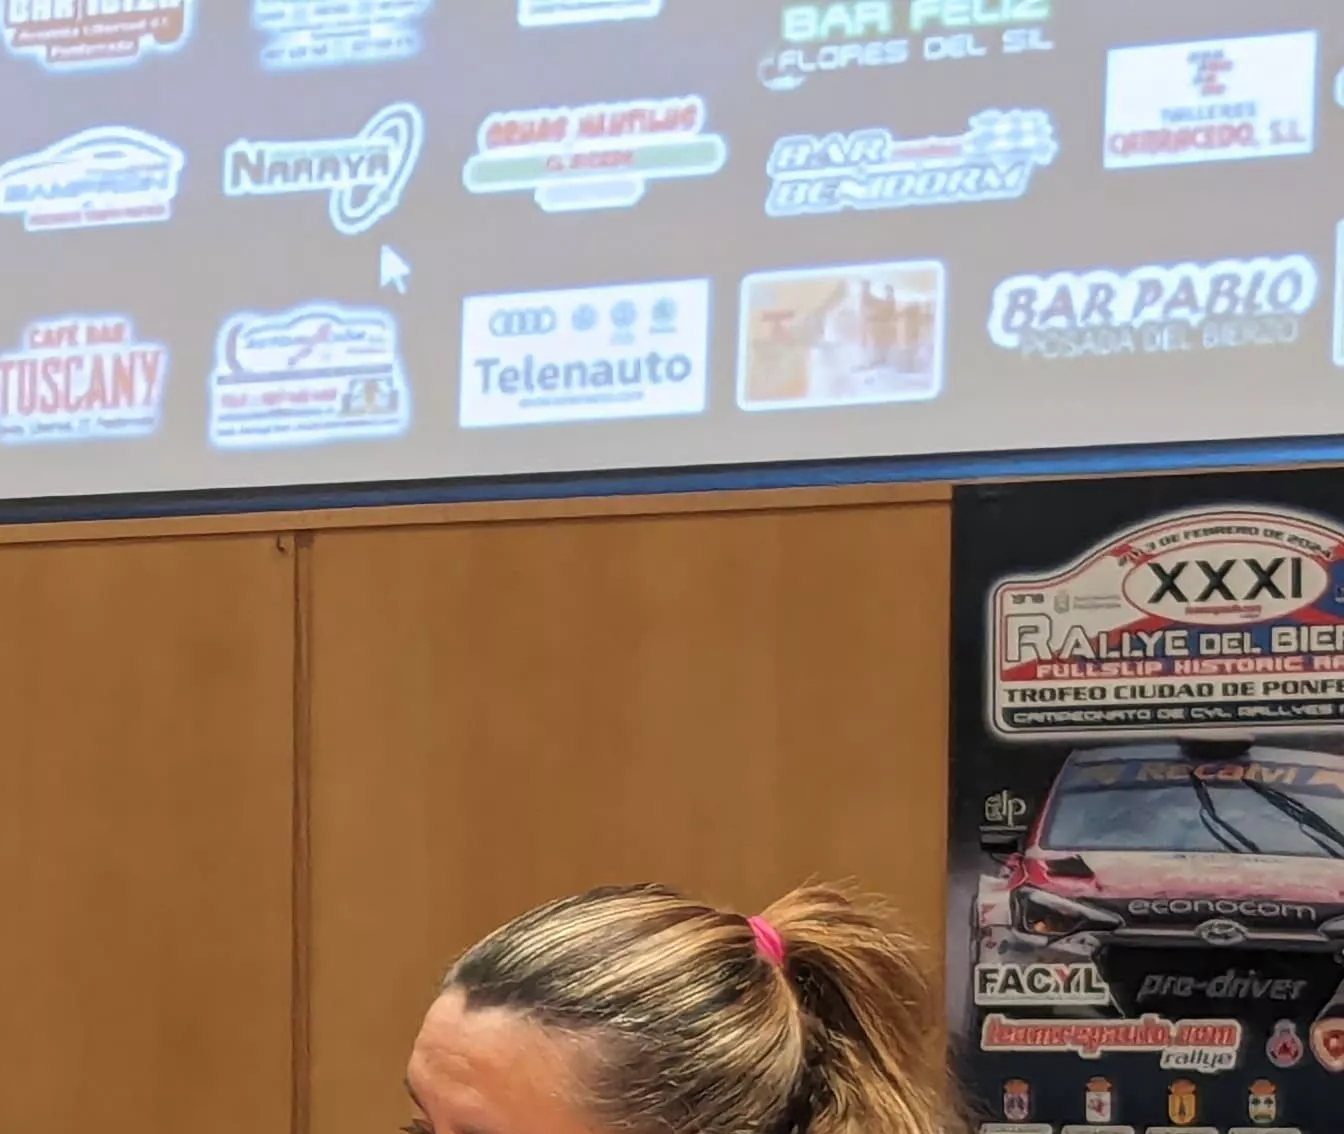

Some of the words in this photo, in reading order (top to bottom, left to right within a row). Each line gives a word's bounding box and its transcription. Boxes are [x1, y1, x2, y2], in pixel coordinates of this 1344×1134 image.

[784, 1, 891, 41] BAR
[777, 40, 909, 71] FLORES
[923, 33, 987, 60] DEL
[1002, 280, 1117, 334] BAR
[1132, 267, 1304, 322] PABLO
[474, 351, 693, 394] Telenauto
[1147, 556, 1303, 604] XXXI
[1004, 613, 1189, 663] RALLYE
[1198, 631, 1262, 656] DEL
[1036, 658, 1162, 680] FULLSLIP
[1174, 655, 1304, 676] HISTORIC
[1003, 684, 1107, 703] TROFEO
[1113, 682, 1216, 701] CIUDAD
[1221, 681, 1255, 697] DE
[1127, 898, 1317, 922] econocom
[977, 965, 1107, 995] FACYL
[1137, 968, 1308, 1002] pro-driver
[1163, 1049, 1233, 1070] rallye
